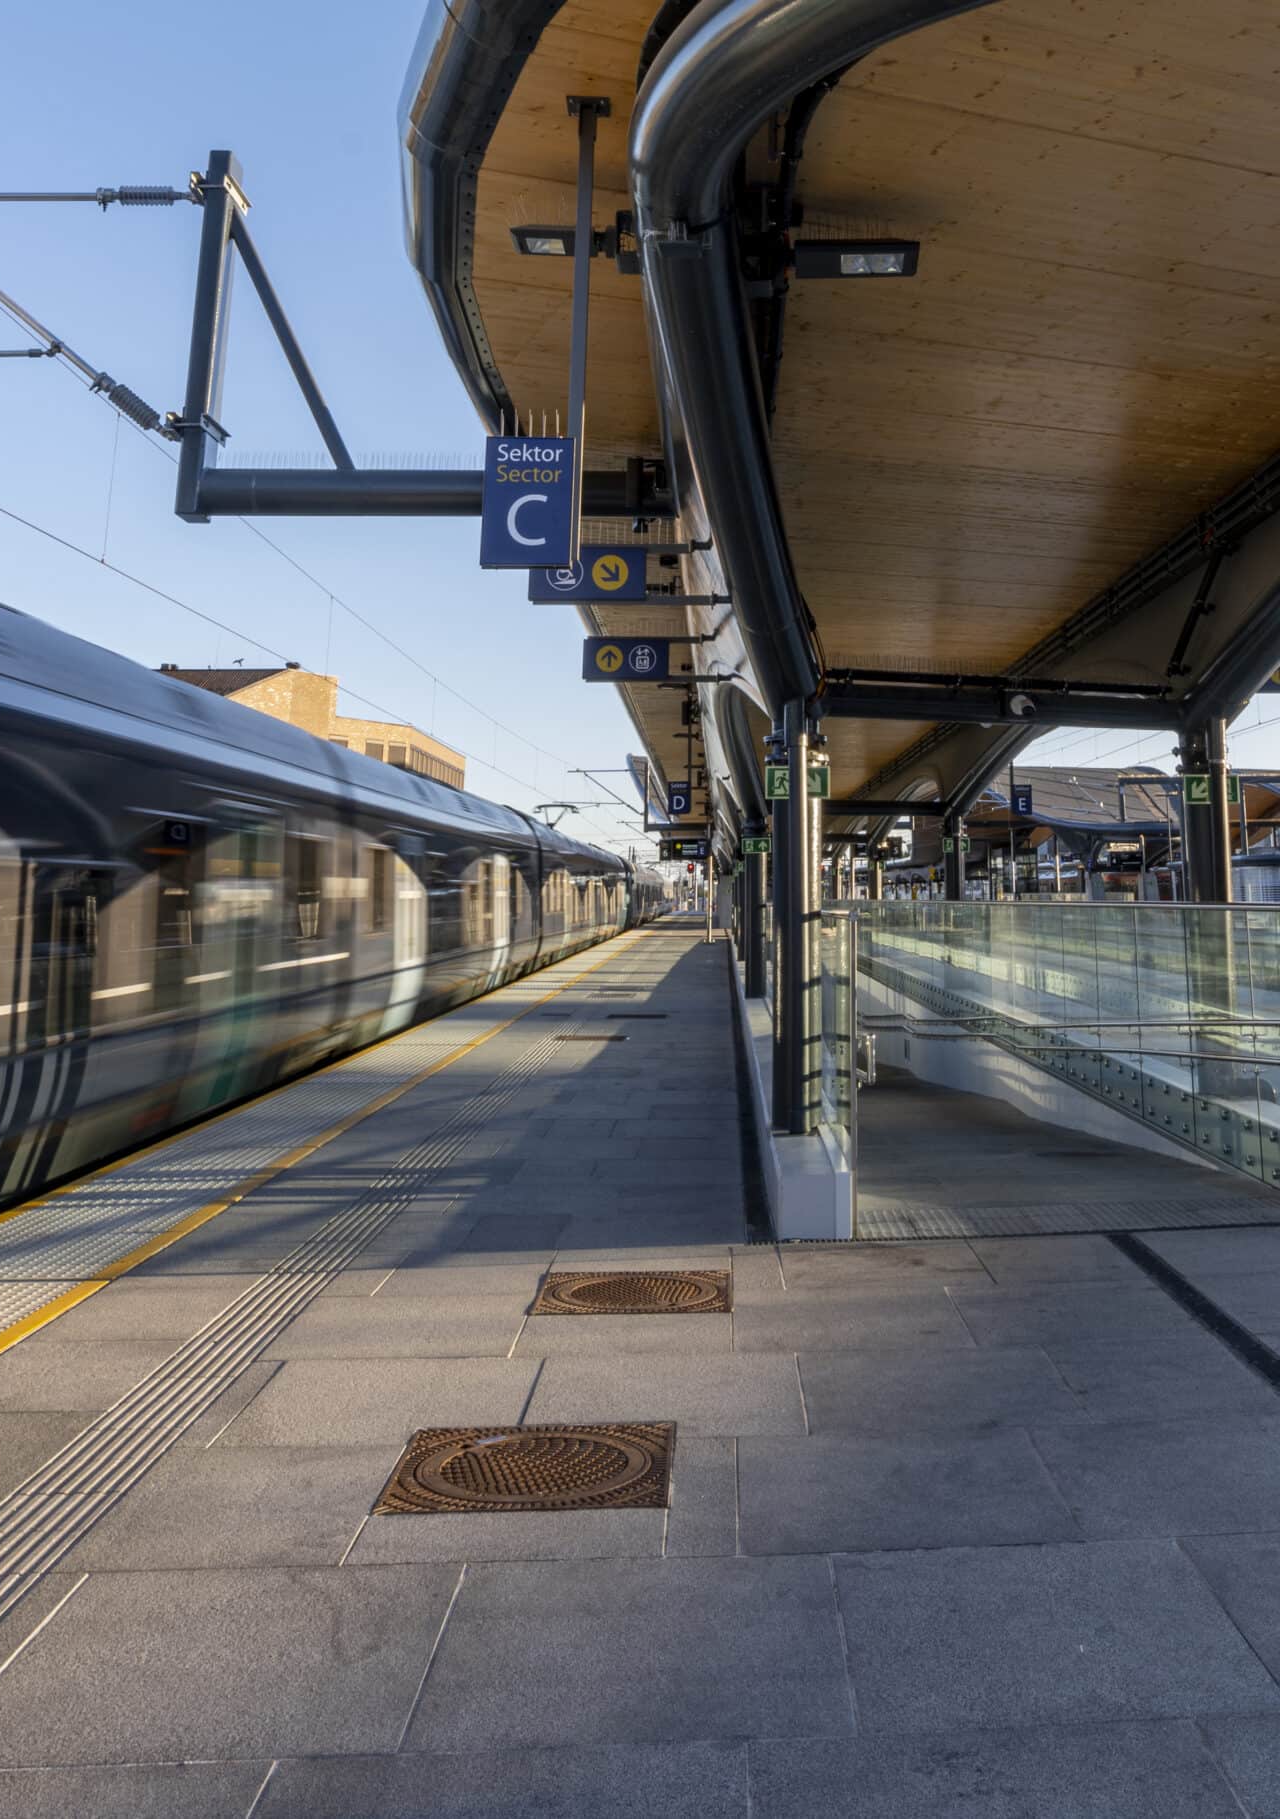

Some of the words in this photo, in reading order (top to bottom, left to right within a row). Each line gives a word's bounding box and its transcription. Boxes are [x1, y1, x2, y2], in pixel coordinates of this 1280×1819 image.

[497, 443, 563, 462] Sektor
[496, 464, 562, 483] Sector
[507, 494, 548, 546] C
[673, 795, 686, 810] D
[1018, 797, 1027, 811] E
